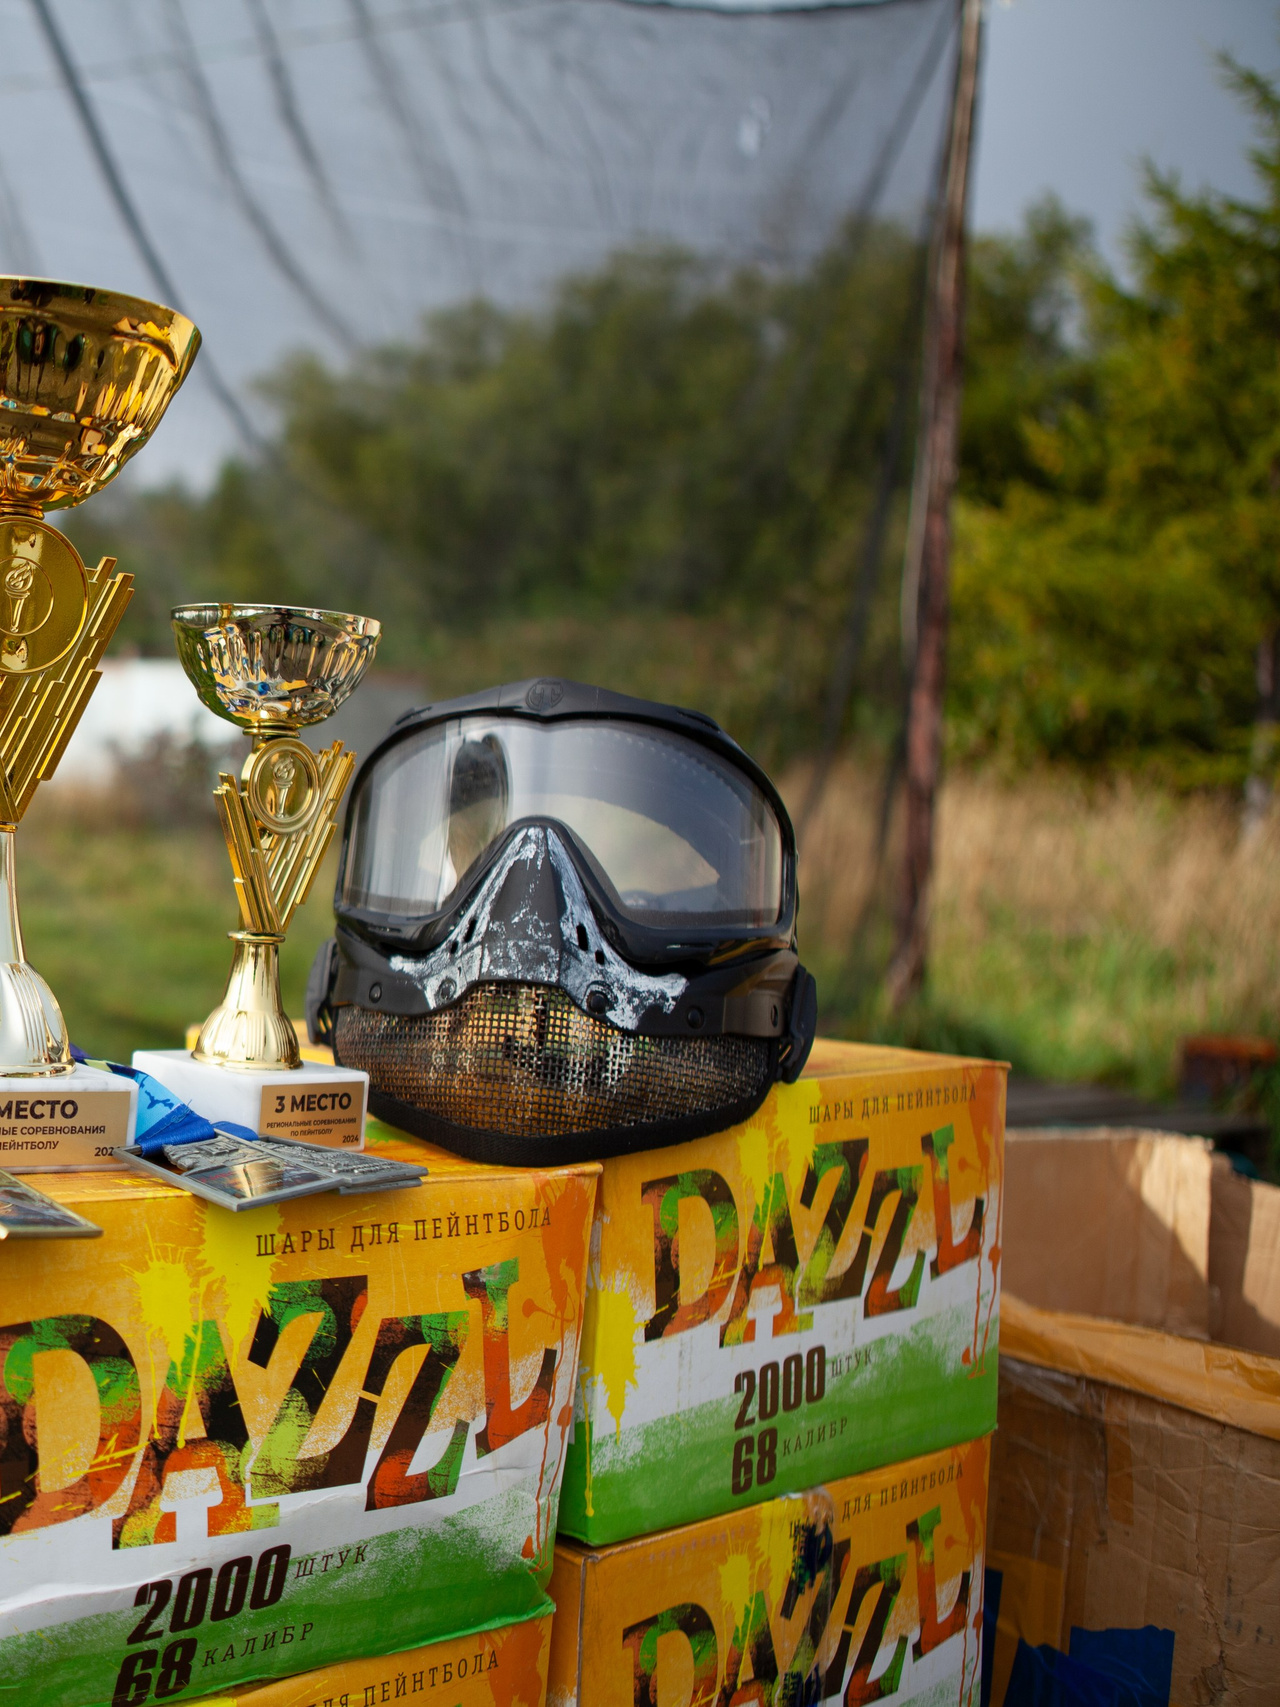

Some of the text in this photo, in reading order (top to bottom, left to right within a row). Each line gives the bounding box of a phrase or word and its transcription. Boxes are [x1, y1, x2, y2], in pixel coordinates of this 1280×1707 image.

[266, 1117, 357, 1129] РЕГИОНАЛЬНЫЕ СОРЕВНОВАНИЯ
[274, 1092, 352, 1113] 3 МЕСТО
[809, 1083, 976, 1124] ШАРЫ ДЛЯ ПЕЙНТБОЛА
[20, 1125, 106, 1136] СОРЕВНОВАНИЯ
[94, 1146, 119, 1157] 202
[299, 1128, 333, 1137] ПЕЙНТБОЛУ
[342, 1135, 359, 1144] 2024
[256, 1206, 552, 1257] ШАРЫ ДЛЯ ПЕЙНТБОЛА
[734, 1344, 872, 1432] 2000 ШТУК
[732, 1416, 848, 1495] 68 КАЛИБР
[842, 1461, 963, 1523] ДЛЯ ПЕЙНТБОЛА
[126, 1544, 369, 1646] 2000 ШТУК
[111, 1622, 314, 1707] 68 КАЛИБР
[363, 1650, 499, 1707] ПЕЙНТБОЛА
